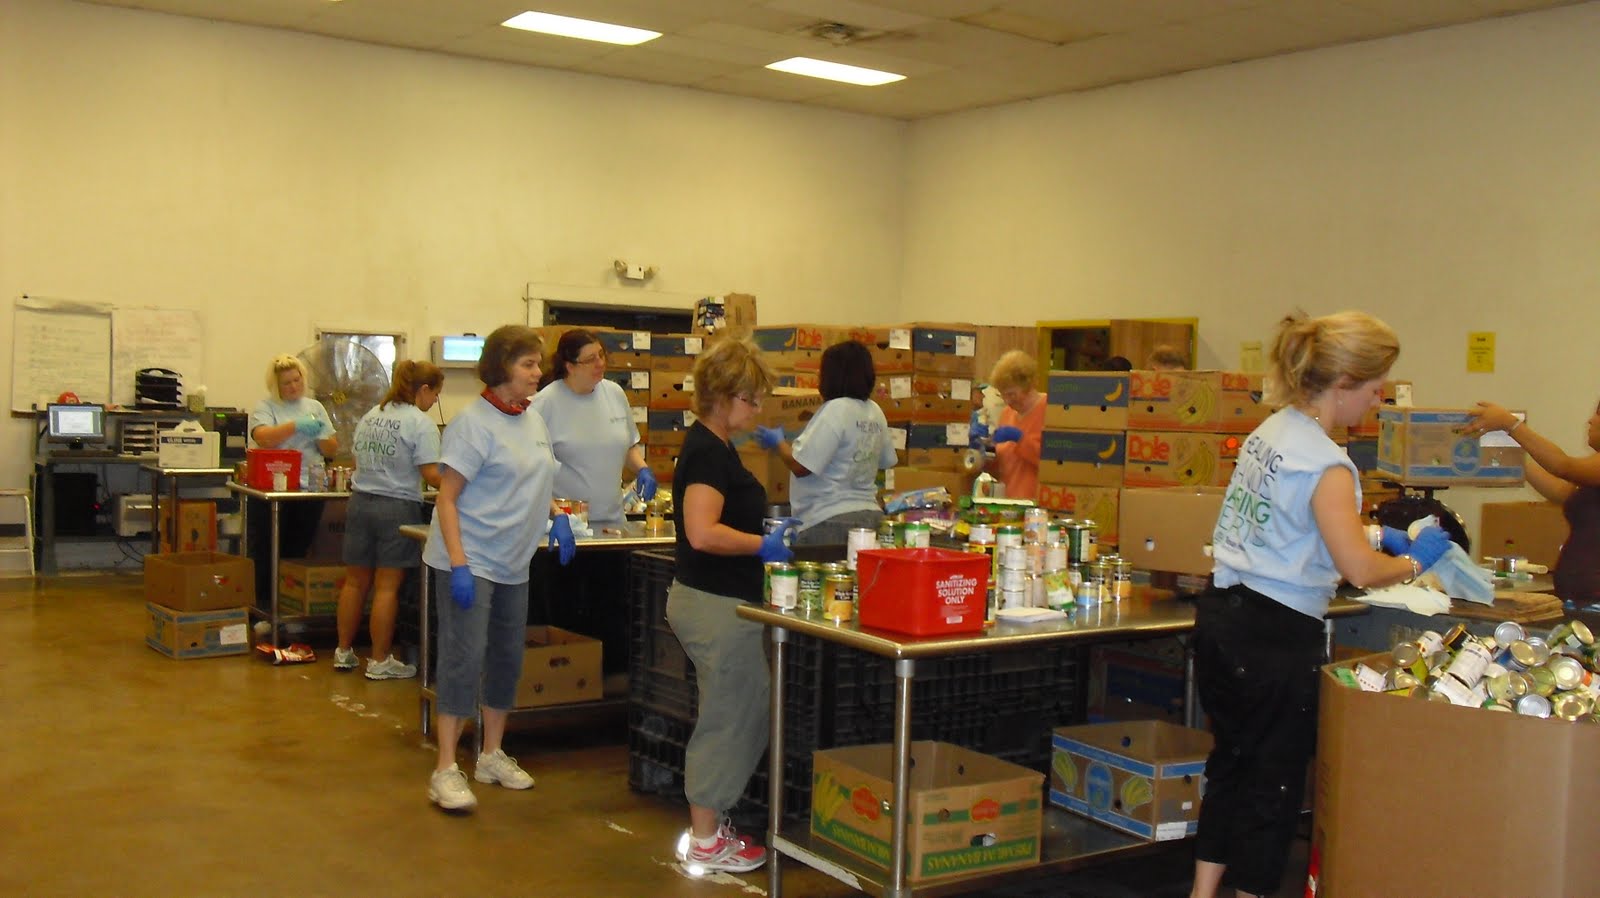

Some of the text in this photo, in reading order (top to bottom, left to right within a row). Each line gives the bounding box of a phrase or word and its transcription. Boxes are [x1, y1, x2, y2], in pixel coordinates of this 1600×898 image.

[1129, 371, 1172, 399] Dole
[1221, 372, 1249, 390] Dole
[1128, 434, 1171, 460] Dole
[1246, 435, 1284, 474] EALING
[1039, 484, 1077, 511] Dole
[1226, 485, 1271, 525] ARING
[935, 578, 978, 590] SANITIZING
[937, 586, 975, 598] SOLUTION
[944, 595, 966, 605] ONLY
